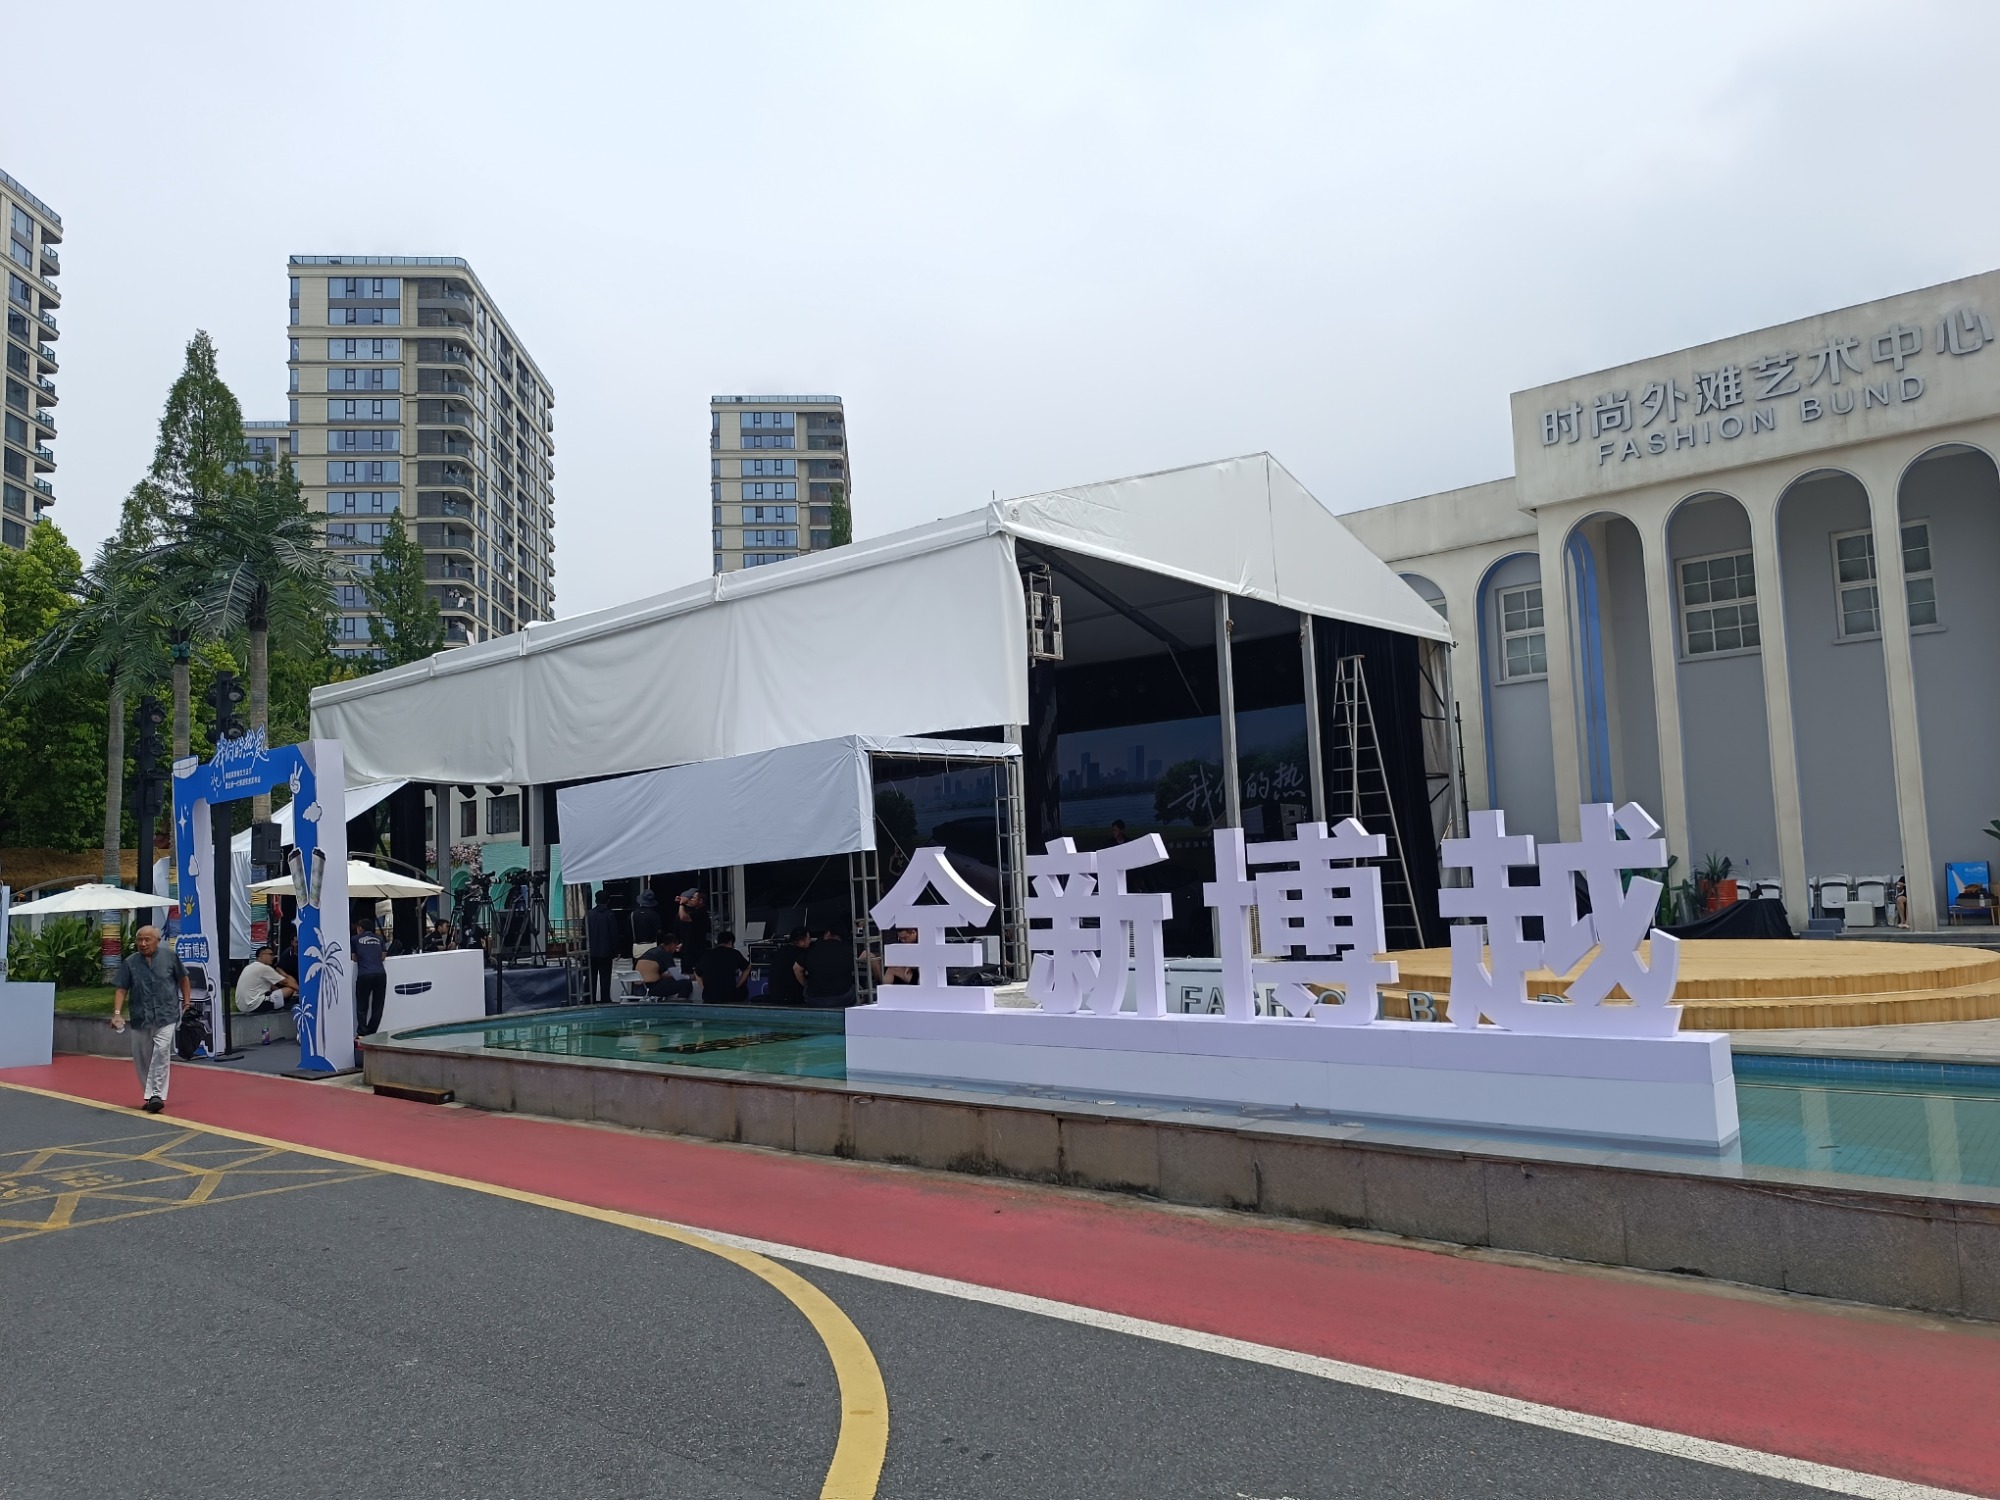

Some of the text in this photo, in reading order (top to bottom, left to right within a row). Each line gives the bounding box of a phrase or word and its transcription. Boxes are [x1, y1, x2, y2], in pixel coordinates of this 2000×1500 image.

[1541, 306, 1994, 447] 时尚外滩艺术中心
[1598, 376, 1926, 466] FASHION BUND
[177, 941, 208, 959] 全新博越
[869, 802, 1685, 1037] 全新博越
